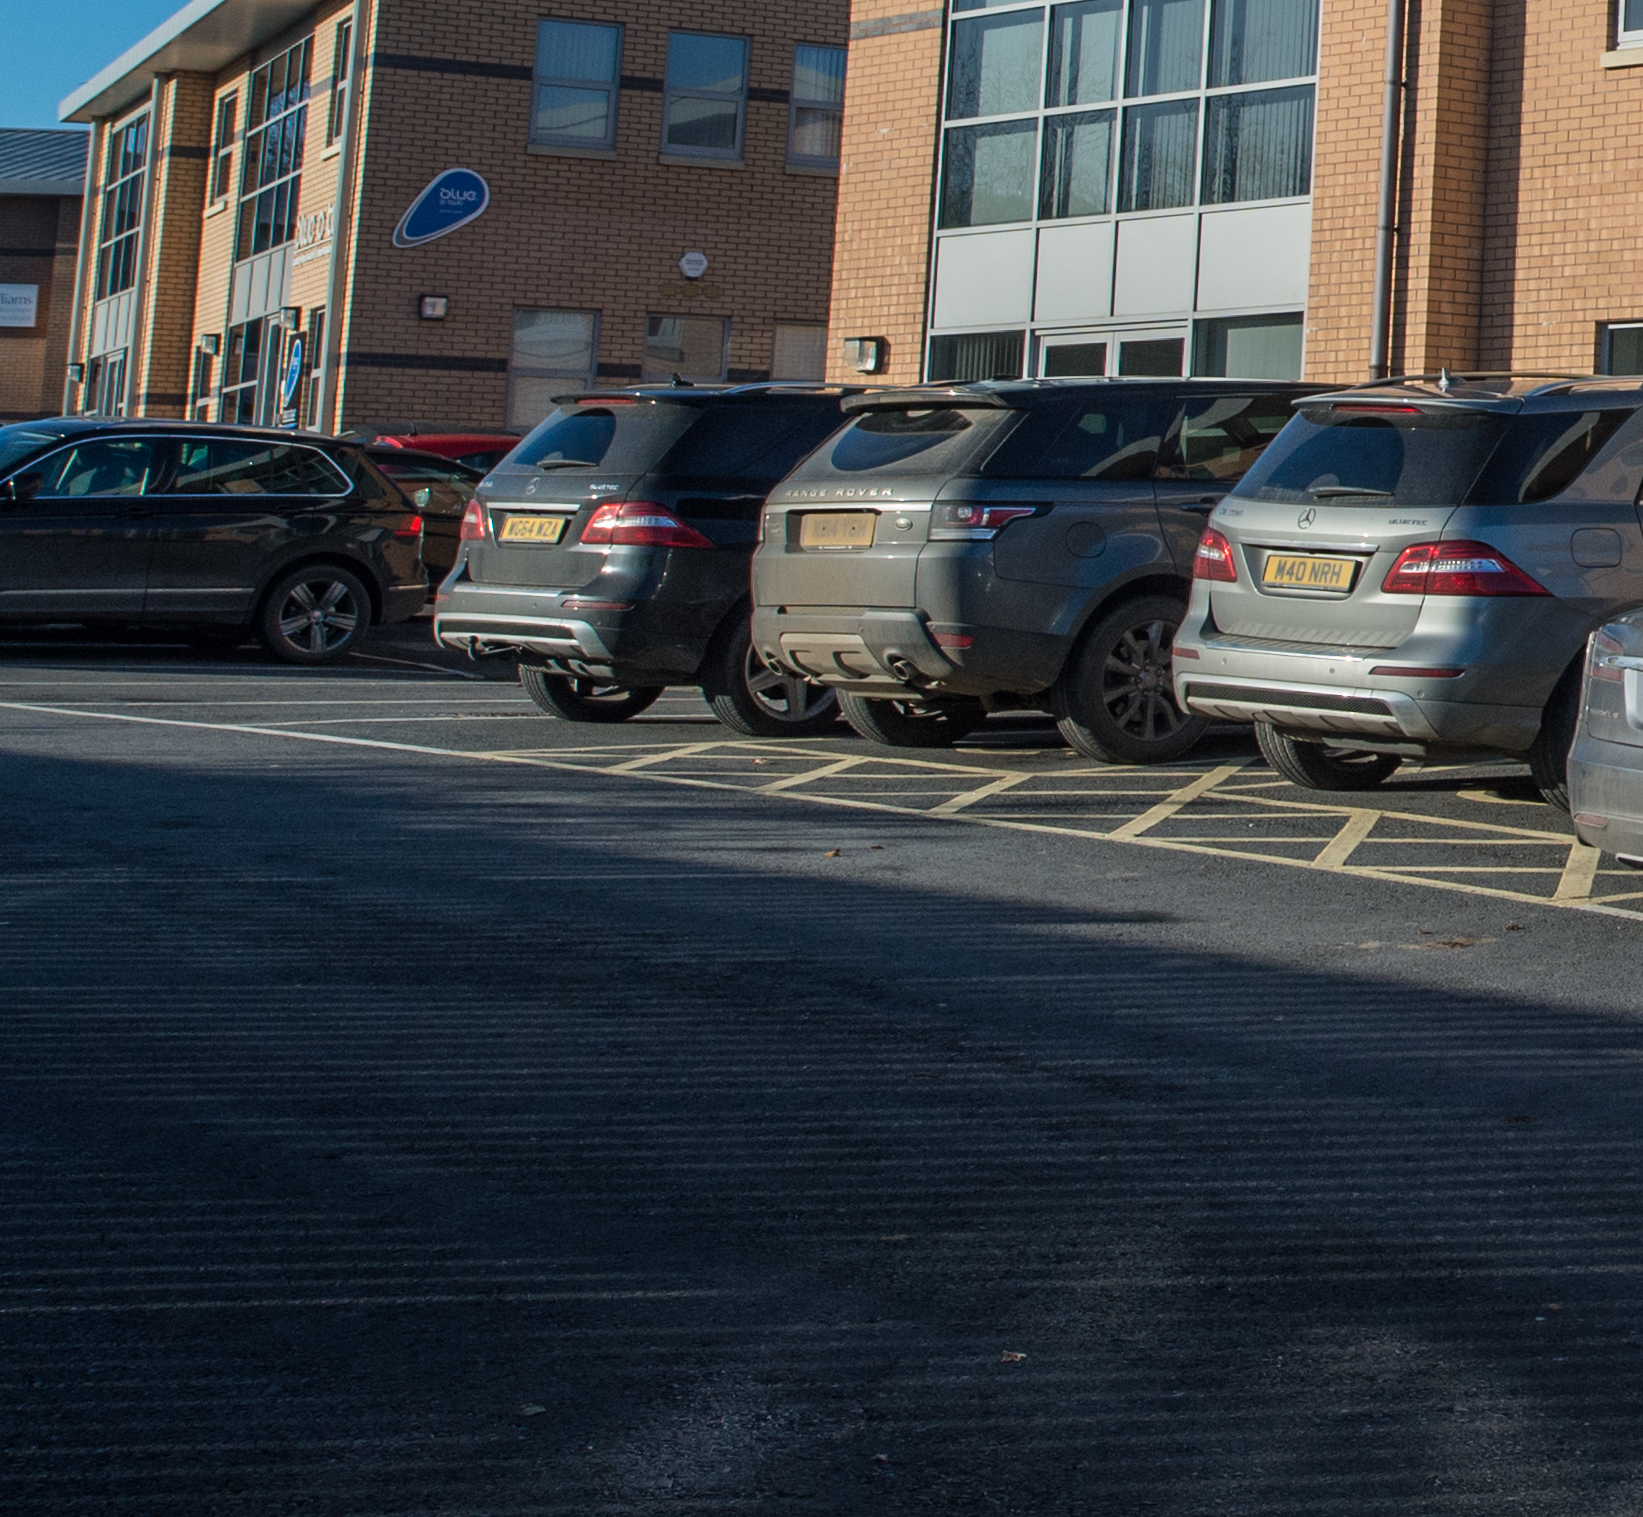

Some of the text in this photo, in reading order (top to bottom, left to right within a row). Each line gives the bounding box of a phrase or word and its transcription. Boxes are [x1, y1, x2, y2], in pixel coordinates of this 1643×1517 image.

[440, 187, 477, 201] blue
[785, 487, 894, 498] RANGE ROVER
[1274, 559, 1344, 585] M40 NRH
